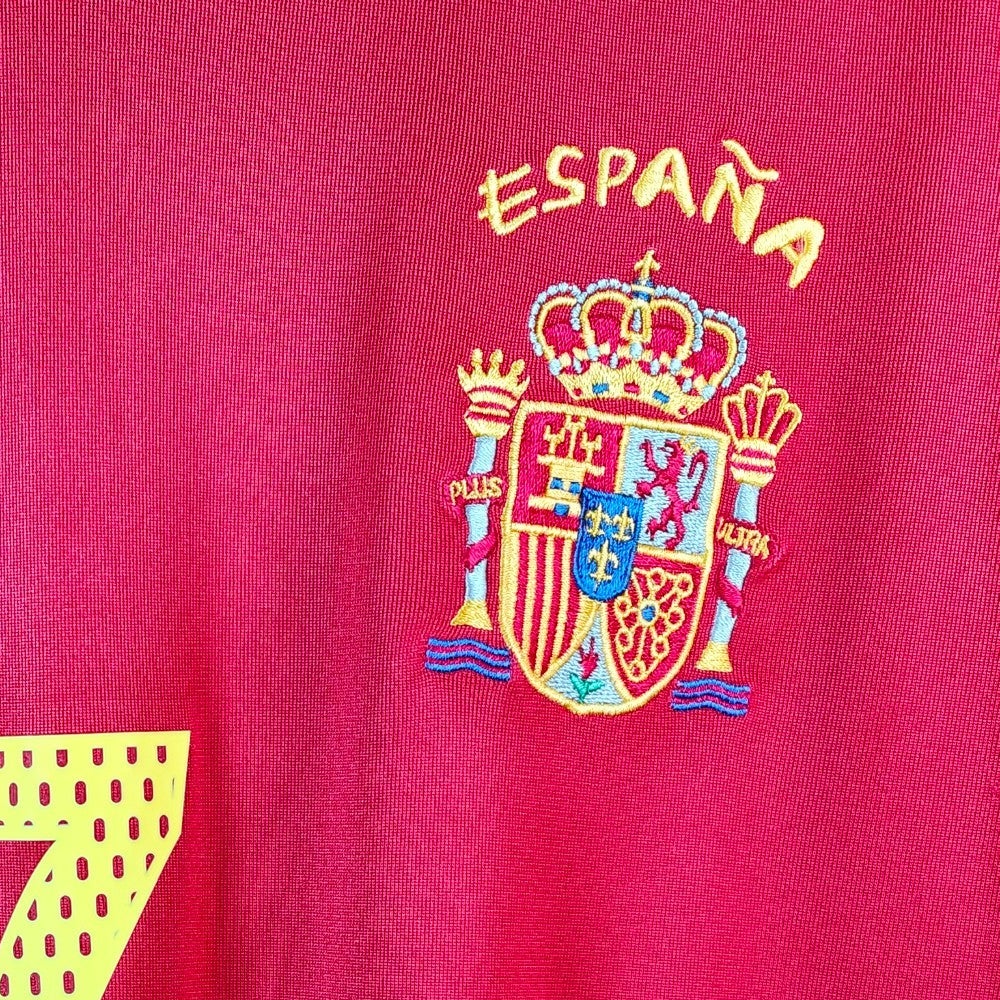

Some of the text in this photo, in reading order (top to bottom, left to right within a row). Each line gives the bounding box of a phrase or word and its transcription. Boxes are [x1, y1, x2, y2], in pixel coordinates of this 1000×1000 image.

[477, 139, 825, 288] ESPAÑA
[449, 475, 503, 506] PLUS
[716, 517, 770, 560] ULTRA
